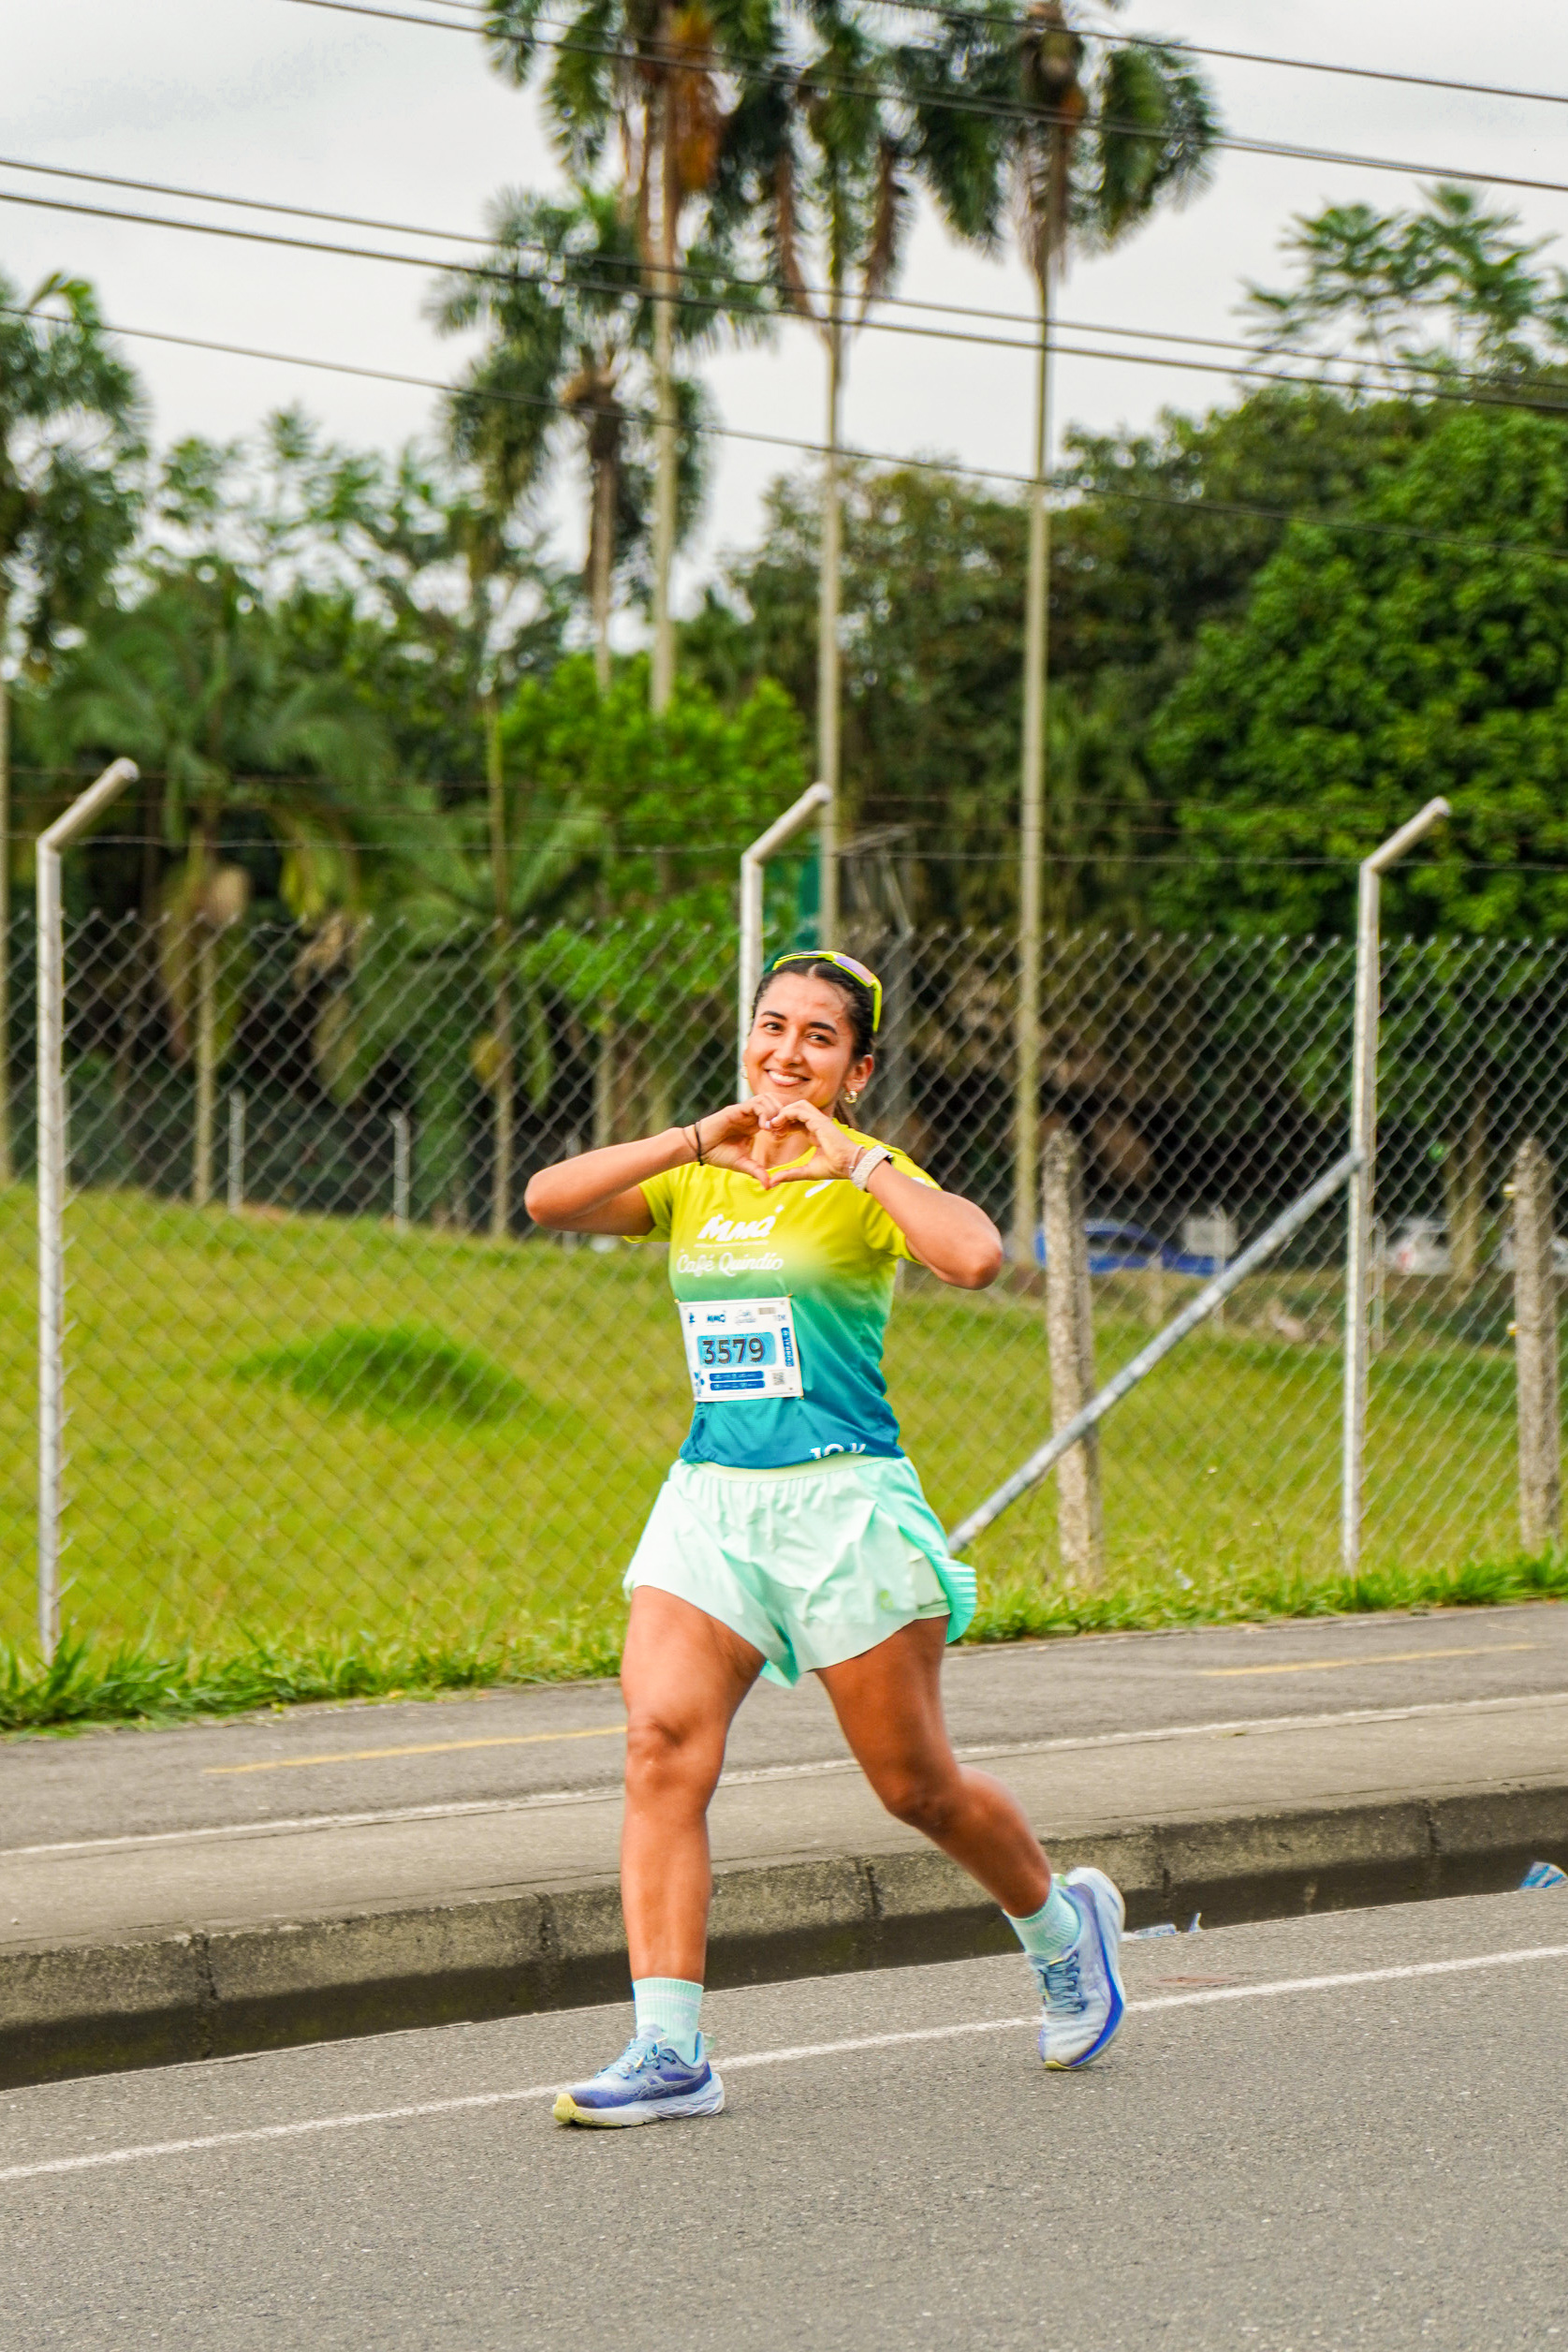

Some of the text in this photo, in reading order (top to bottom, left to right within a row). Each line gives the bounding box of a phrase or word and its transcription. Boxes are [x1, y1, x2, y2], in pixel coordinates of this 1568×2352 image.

[677, 1252, 784, 1277] Café Quindío
[702, 1337, 764, 1364] 3579
